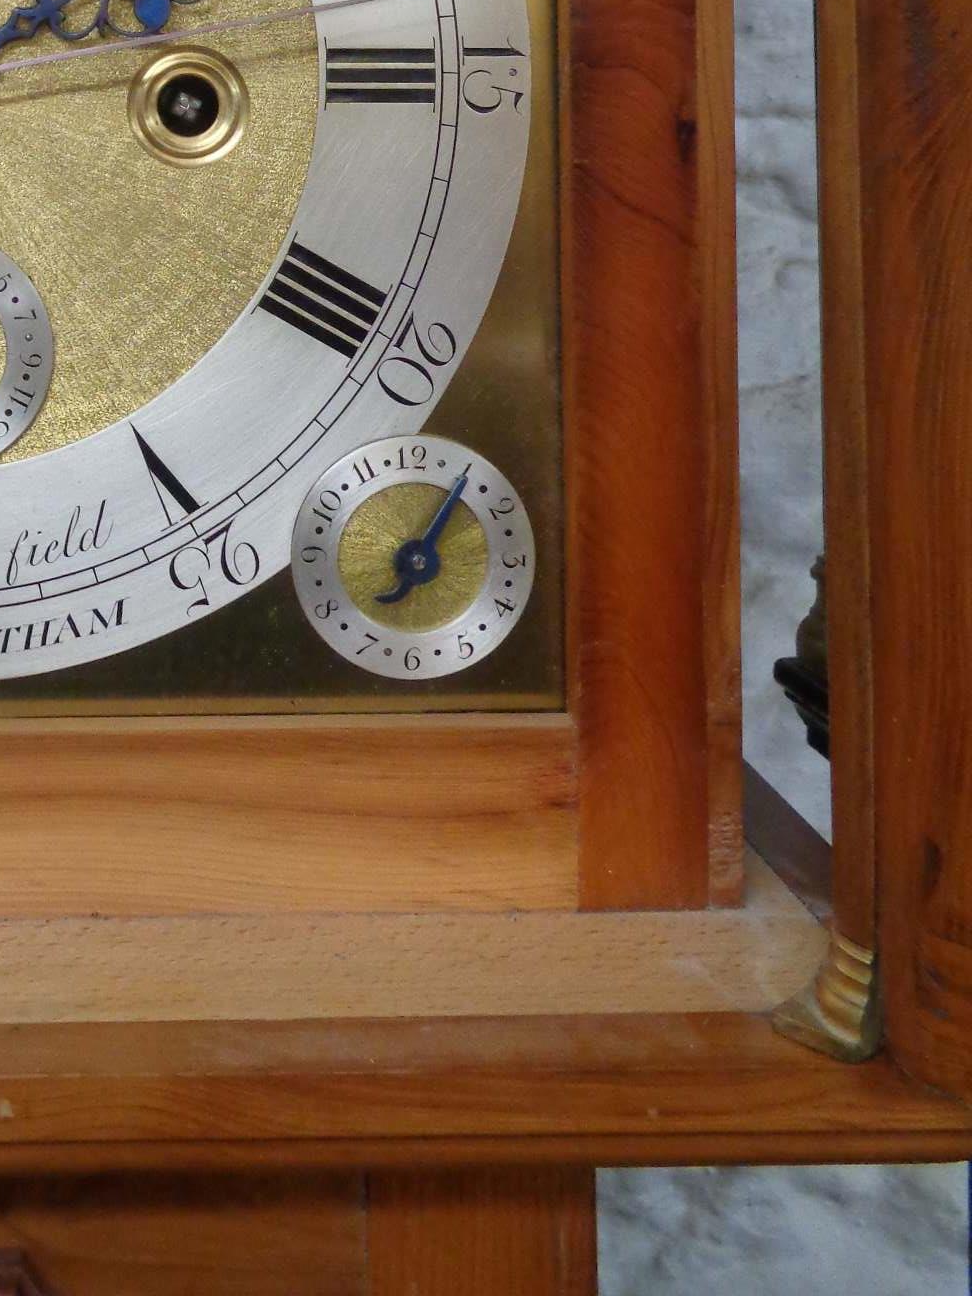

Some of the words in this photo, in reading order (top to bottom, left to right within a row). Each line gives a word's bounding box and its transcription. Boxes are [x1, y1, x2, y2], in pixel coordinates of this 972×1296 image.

[323, 36, 436, 114] III
[462, 35, 526, 115] 15
[13, 308, 37, 322] 7
[19, 352, 43, 370] 9
[376, 310, 457, 407] 20
[10, 385, 37, 414] 11
[352, 456, 380, 487] 11
[395, 445, 428, 472] 12
[128, 420, 210, 533] V
[312, 489, 342, 528] 10
[488, 496, 516, 522] 2
[5, 499, 115, 587] field
[169, 517, 260, 617] 25
[501, 553, 527, 570] 3
[313, 599, 339, 621] 8
[493, 597, 516, 618] 4
[355, 633, 379, 655] 7
[456, 630, 474, 660] 5
[403, 646, 422, 672] 6
